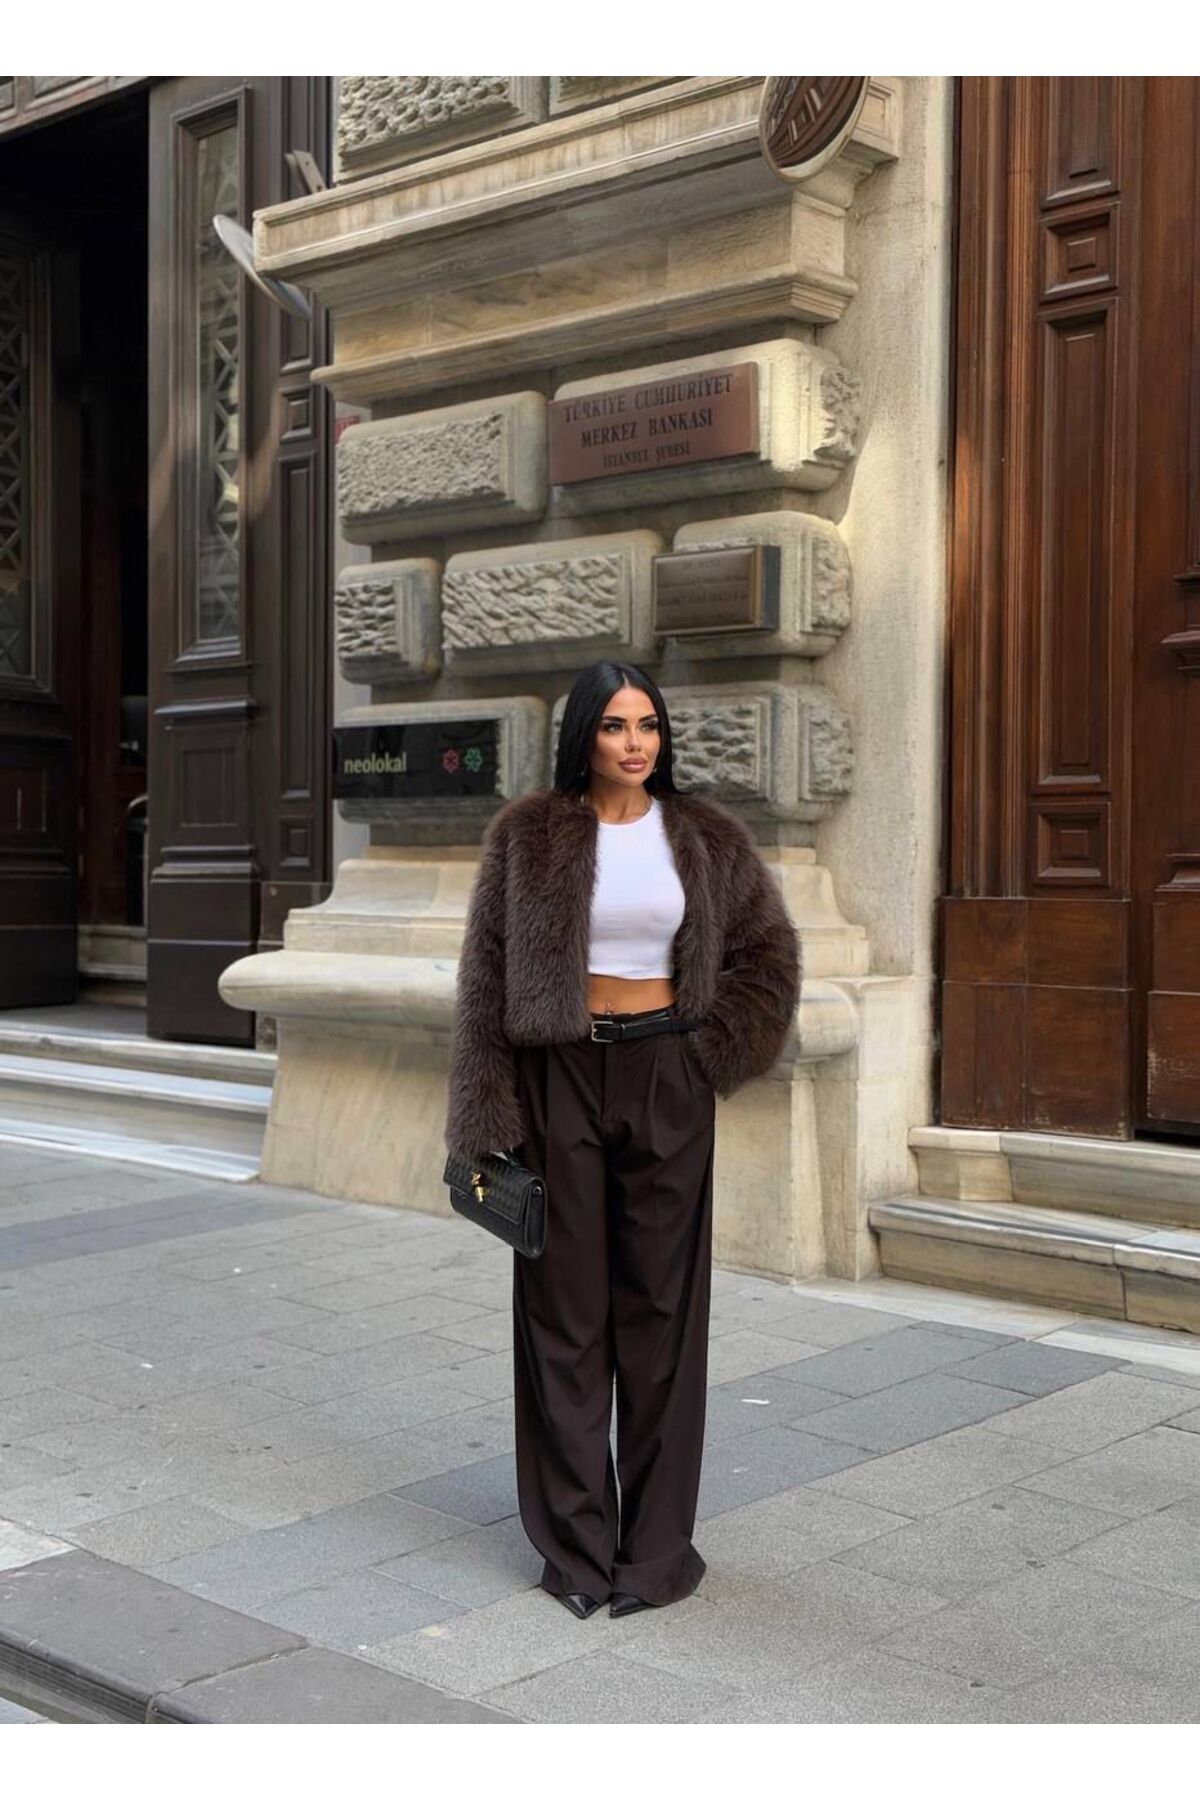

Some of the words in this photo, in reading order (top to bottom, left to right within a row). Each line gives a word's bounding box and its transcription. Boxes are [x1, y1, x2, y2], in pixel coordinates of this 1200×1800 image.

[564, 393, 626, 422] TÜRKİYE
[634, 374, 733, 410] CUMHURİYET
[581, 421, 638, 448] MERKEZ
[648, 408, 713, 436] BANKASI
[344, 751, 407, 774] neolokal
